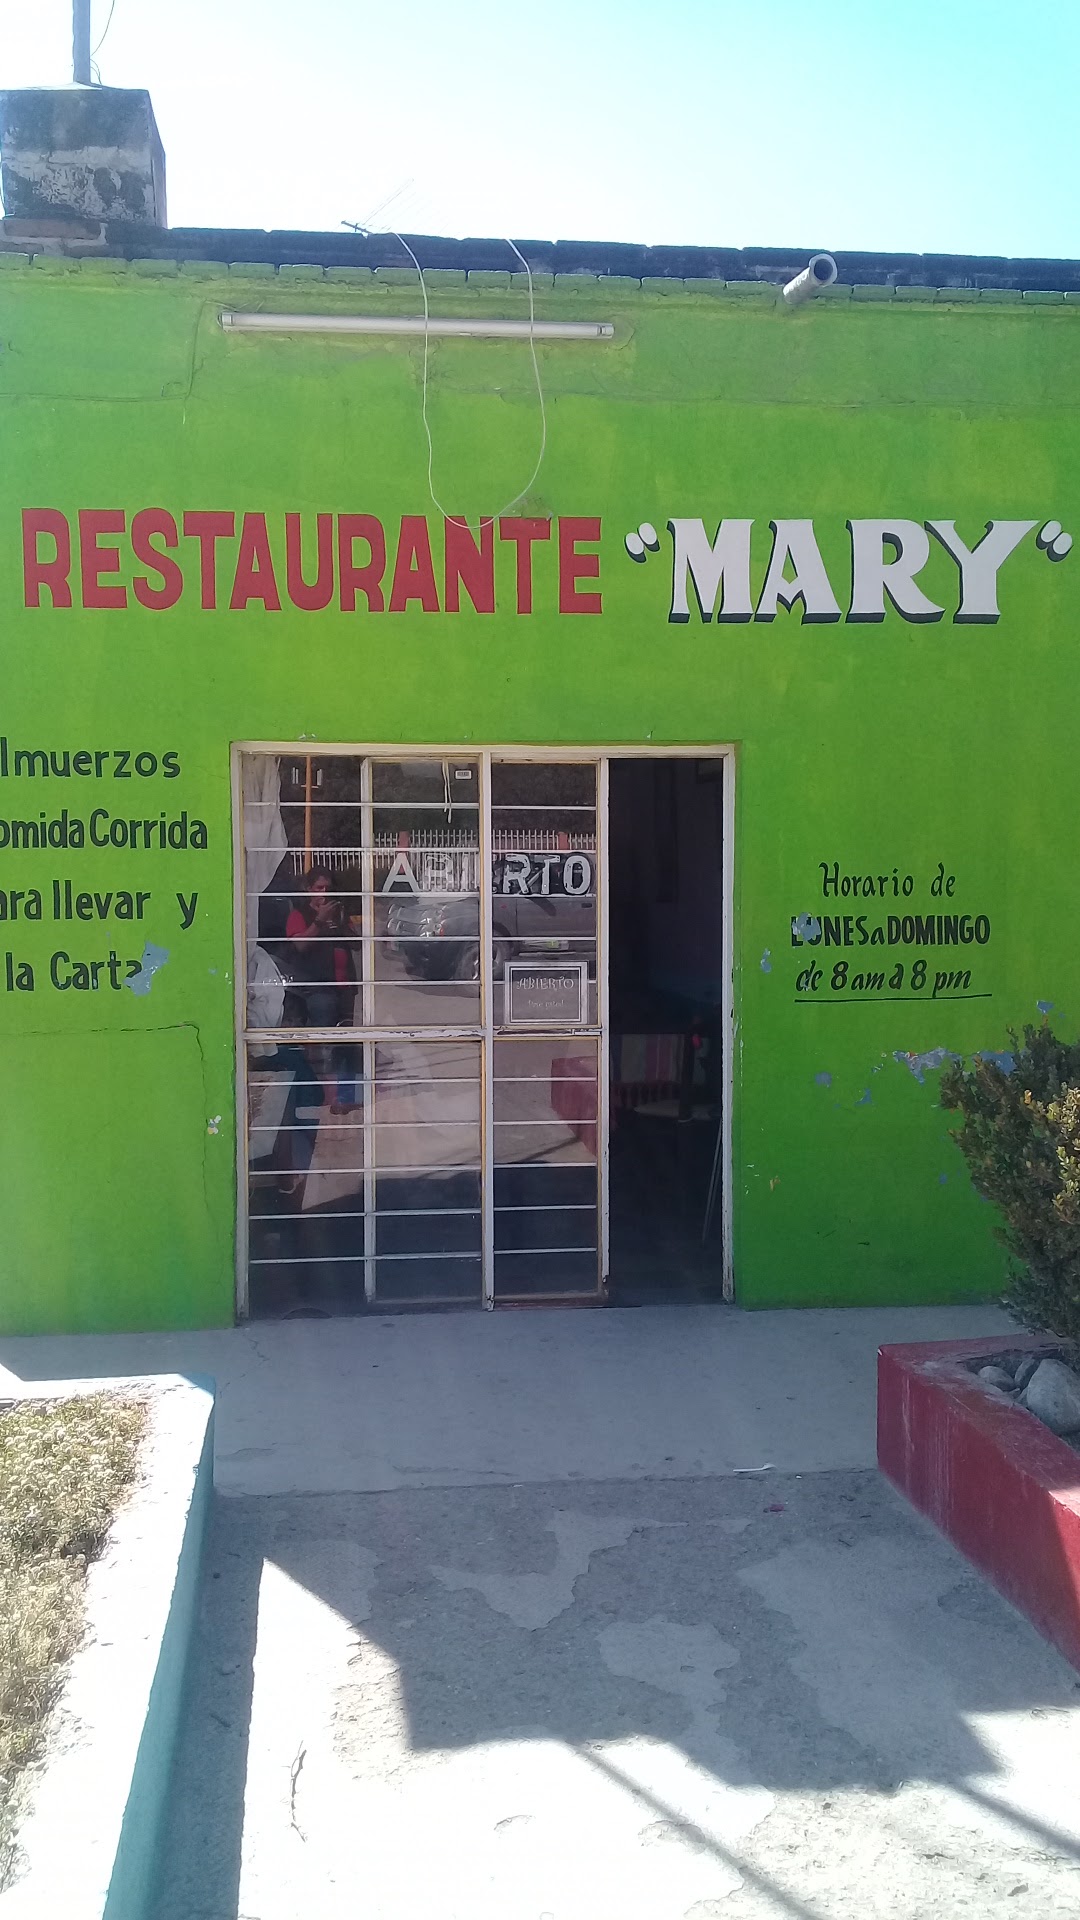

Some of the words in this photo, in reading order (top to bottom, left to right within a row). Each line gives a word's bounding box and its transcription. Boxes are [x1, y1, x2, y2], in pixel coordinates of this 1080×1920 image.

[20, 507, 603, 615] RESTAURANTE
[89, 808, 209, 850] Corrida
[382, 850, 594, 896] ABIRTO
[818, 861, 914, 898] Horario
[930, 861, 956, 898] de
[52, 879, 151, 921] llevar
[176, 892, 199, 931] y
[887, 914, 991, 946] DOMINGO
[5, 951, 35, 992] la
[516, 975, 575, 992] ABIERTO
[795, 959, 824, 992] de
[830, 960, 849, 991] 8
[910, 959, 928, 991] 8
[931, 968, 972, 999] pm
